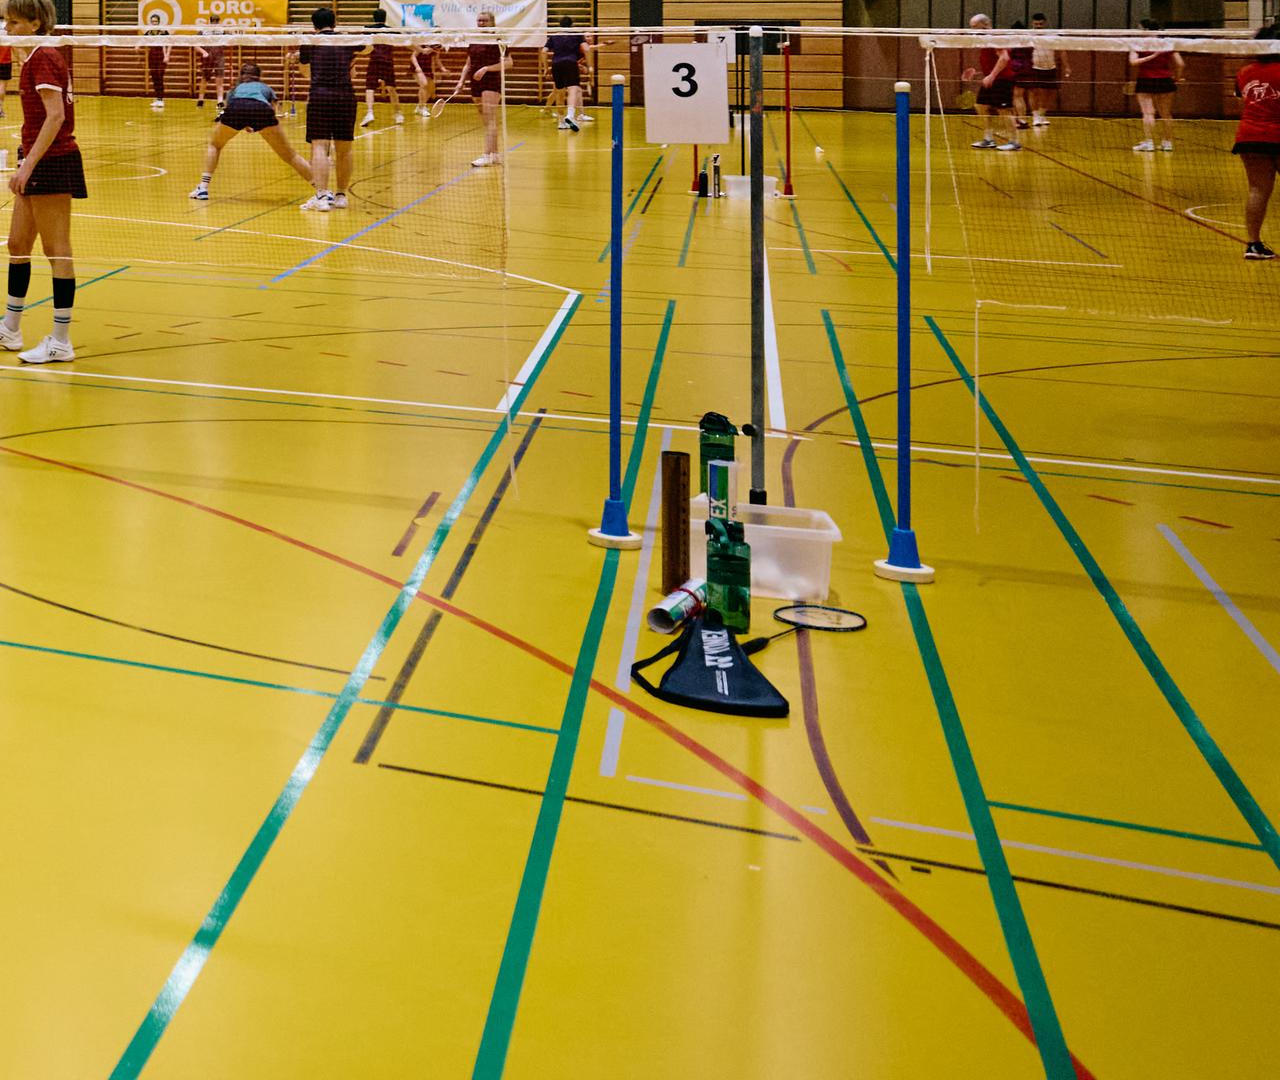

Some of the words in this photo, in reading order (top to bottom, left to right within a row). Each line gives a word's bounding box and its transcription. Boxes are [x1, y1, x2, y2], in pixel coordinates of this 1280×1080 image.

[198, 0, 262, 15] LORO-
[466, 4, 478, 13] de
[195, 18, 265, 28] SORT
[671, 62, 698, 98] 3
